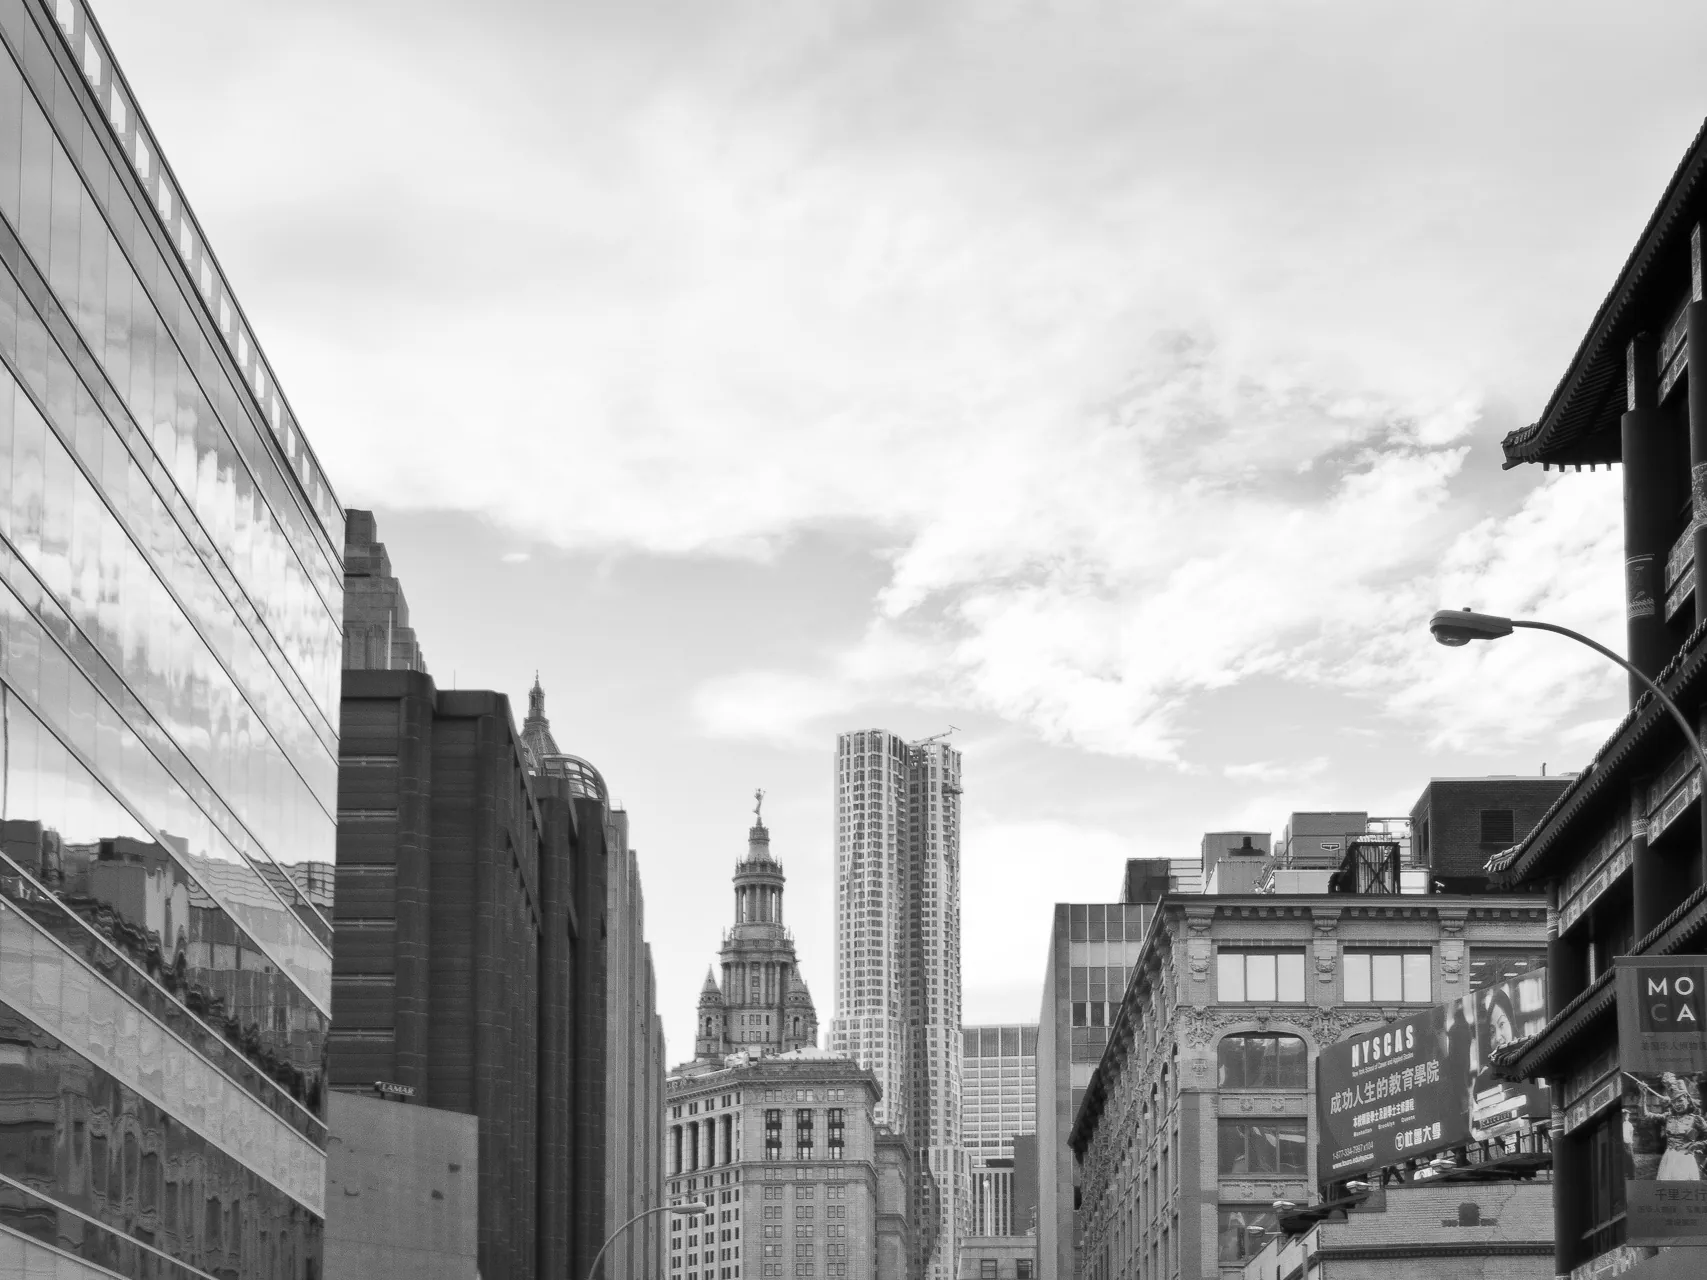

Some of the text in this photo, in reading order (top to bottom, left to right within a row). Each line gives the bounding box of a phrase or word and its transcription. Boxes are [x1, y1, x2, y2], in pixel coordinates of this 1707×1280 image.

[1351, 1024, 1414, 1068] NYSCAS
[382, 1083, 414, 1094] LAMAR
[1330, 1059, 1440, 1115] 成功人生的教育學院
[1378, 1121, 1395, 1130] Brooklyn
[1401, 1115, 1416, 1123] Queens
